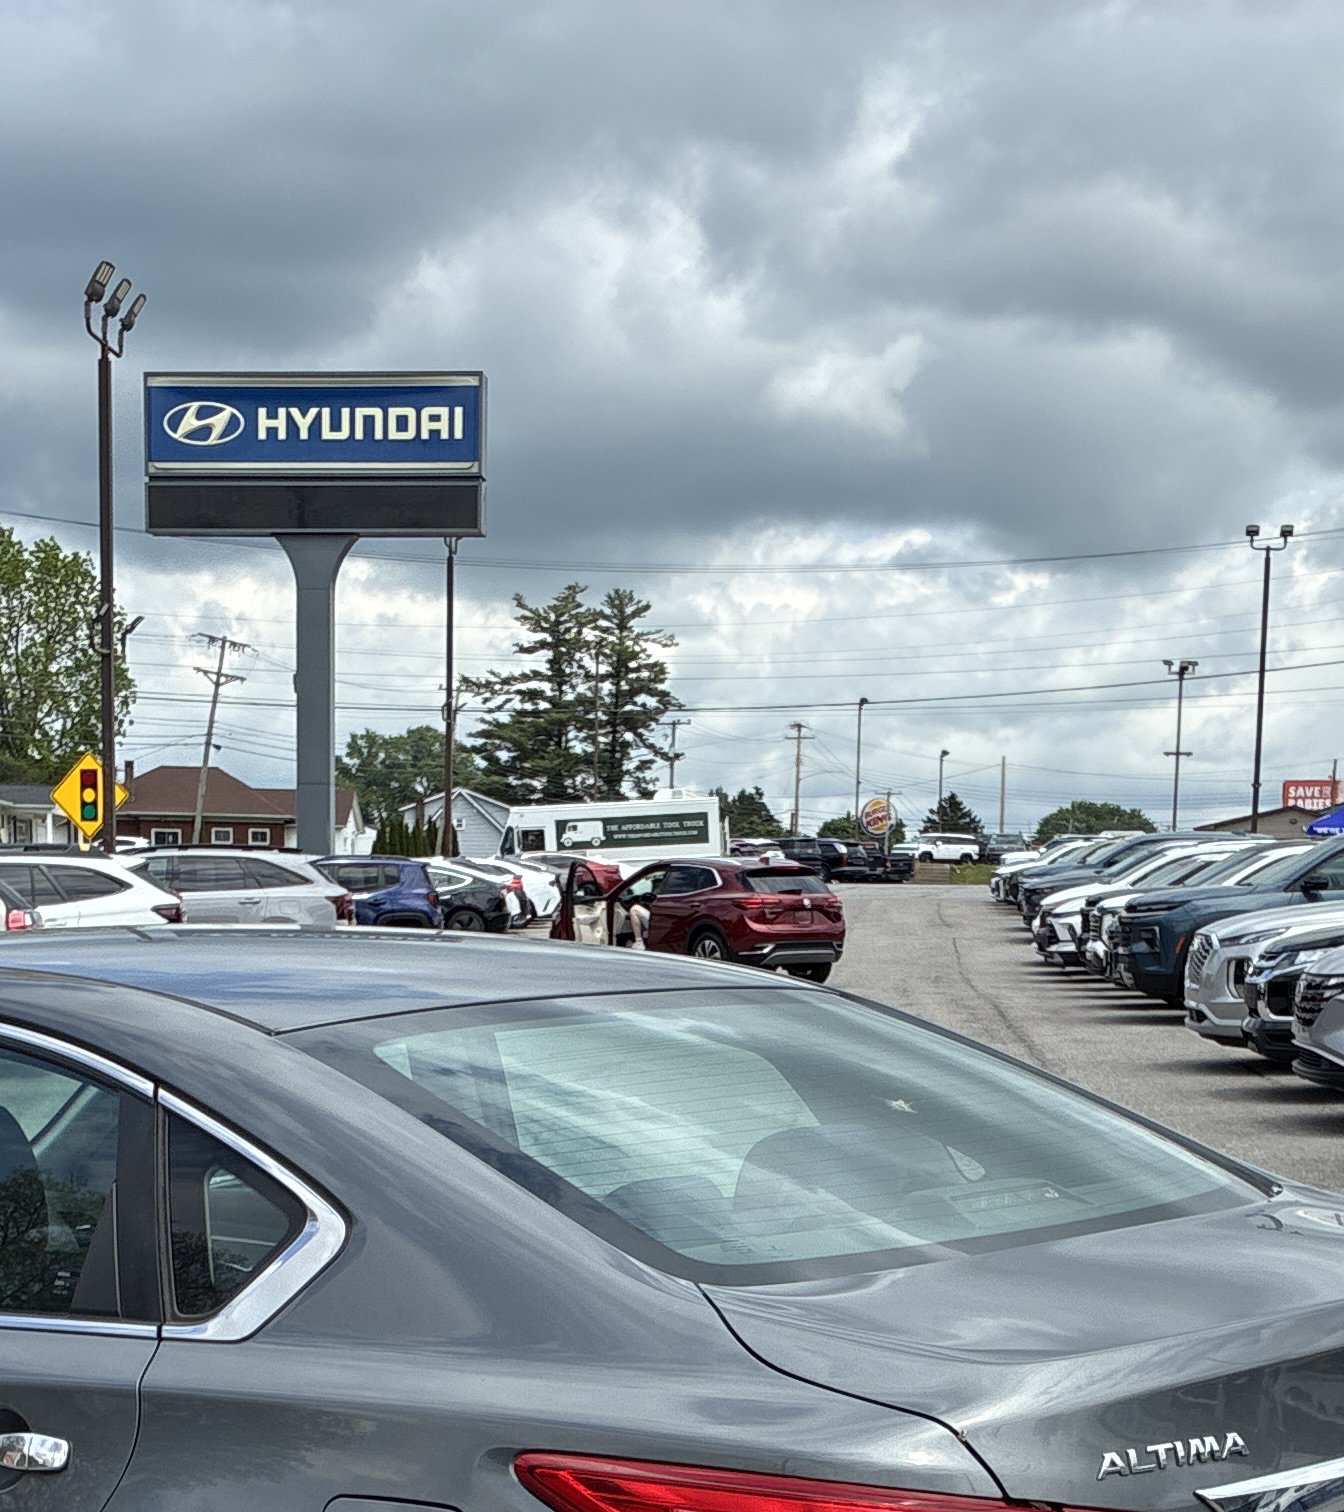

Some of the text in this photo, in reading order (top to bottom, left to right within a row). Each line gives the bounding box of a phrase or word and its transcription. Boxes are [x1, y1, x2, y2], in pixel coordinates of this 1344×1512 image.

[257, 406, 464, 440] HYUNDAI
[1288, 786, 1321, 798] SAVE
[1096, 1431, 1251, 1482] ALTIMA
